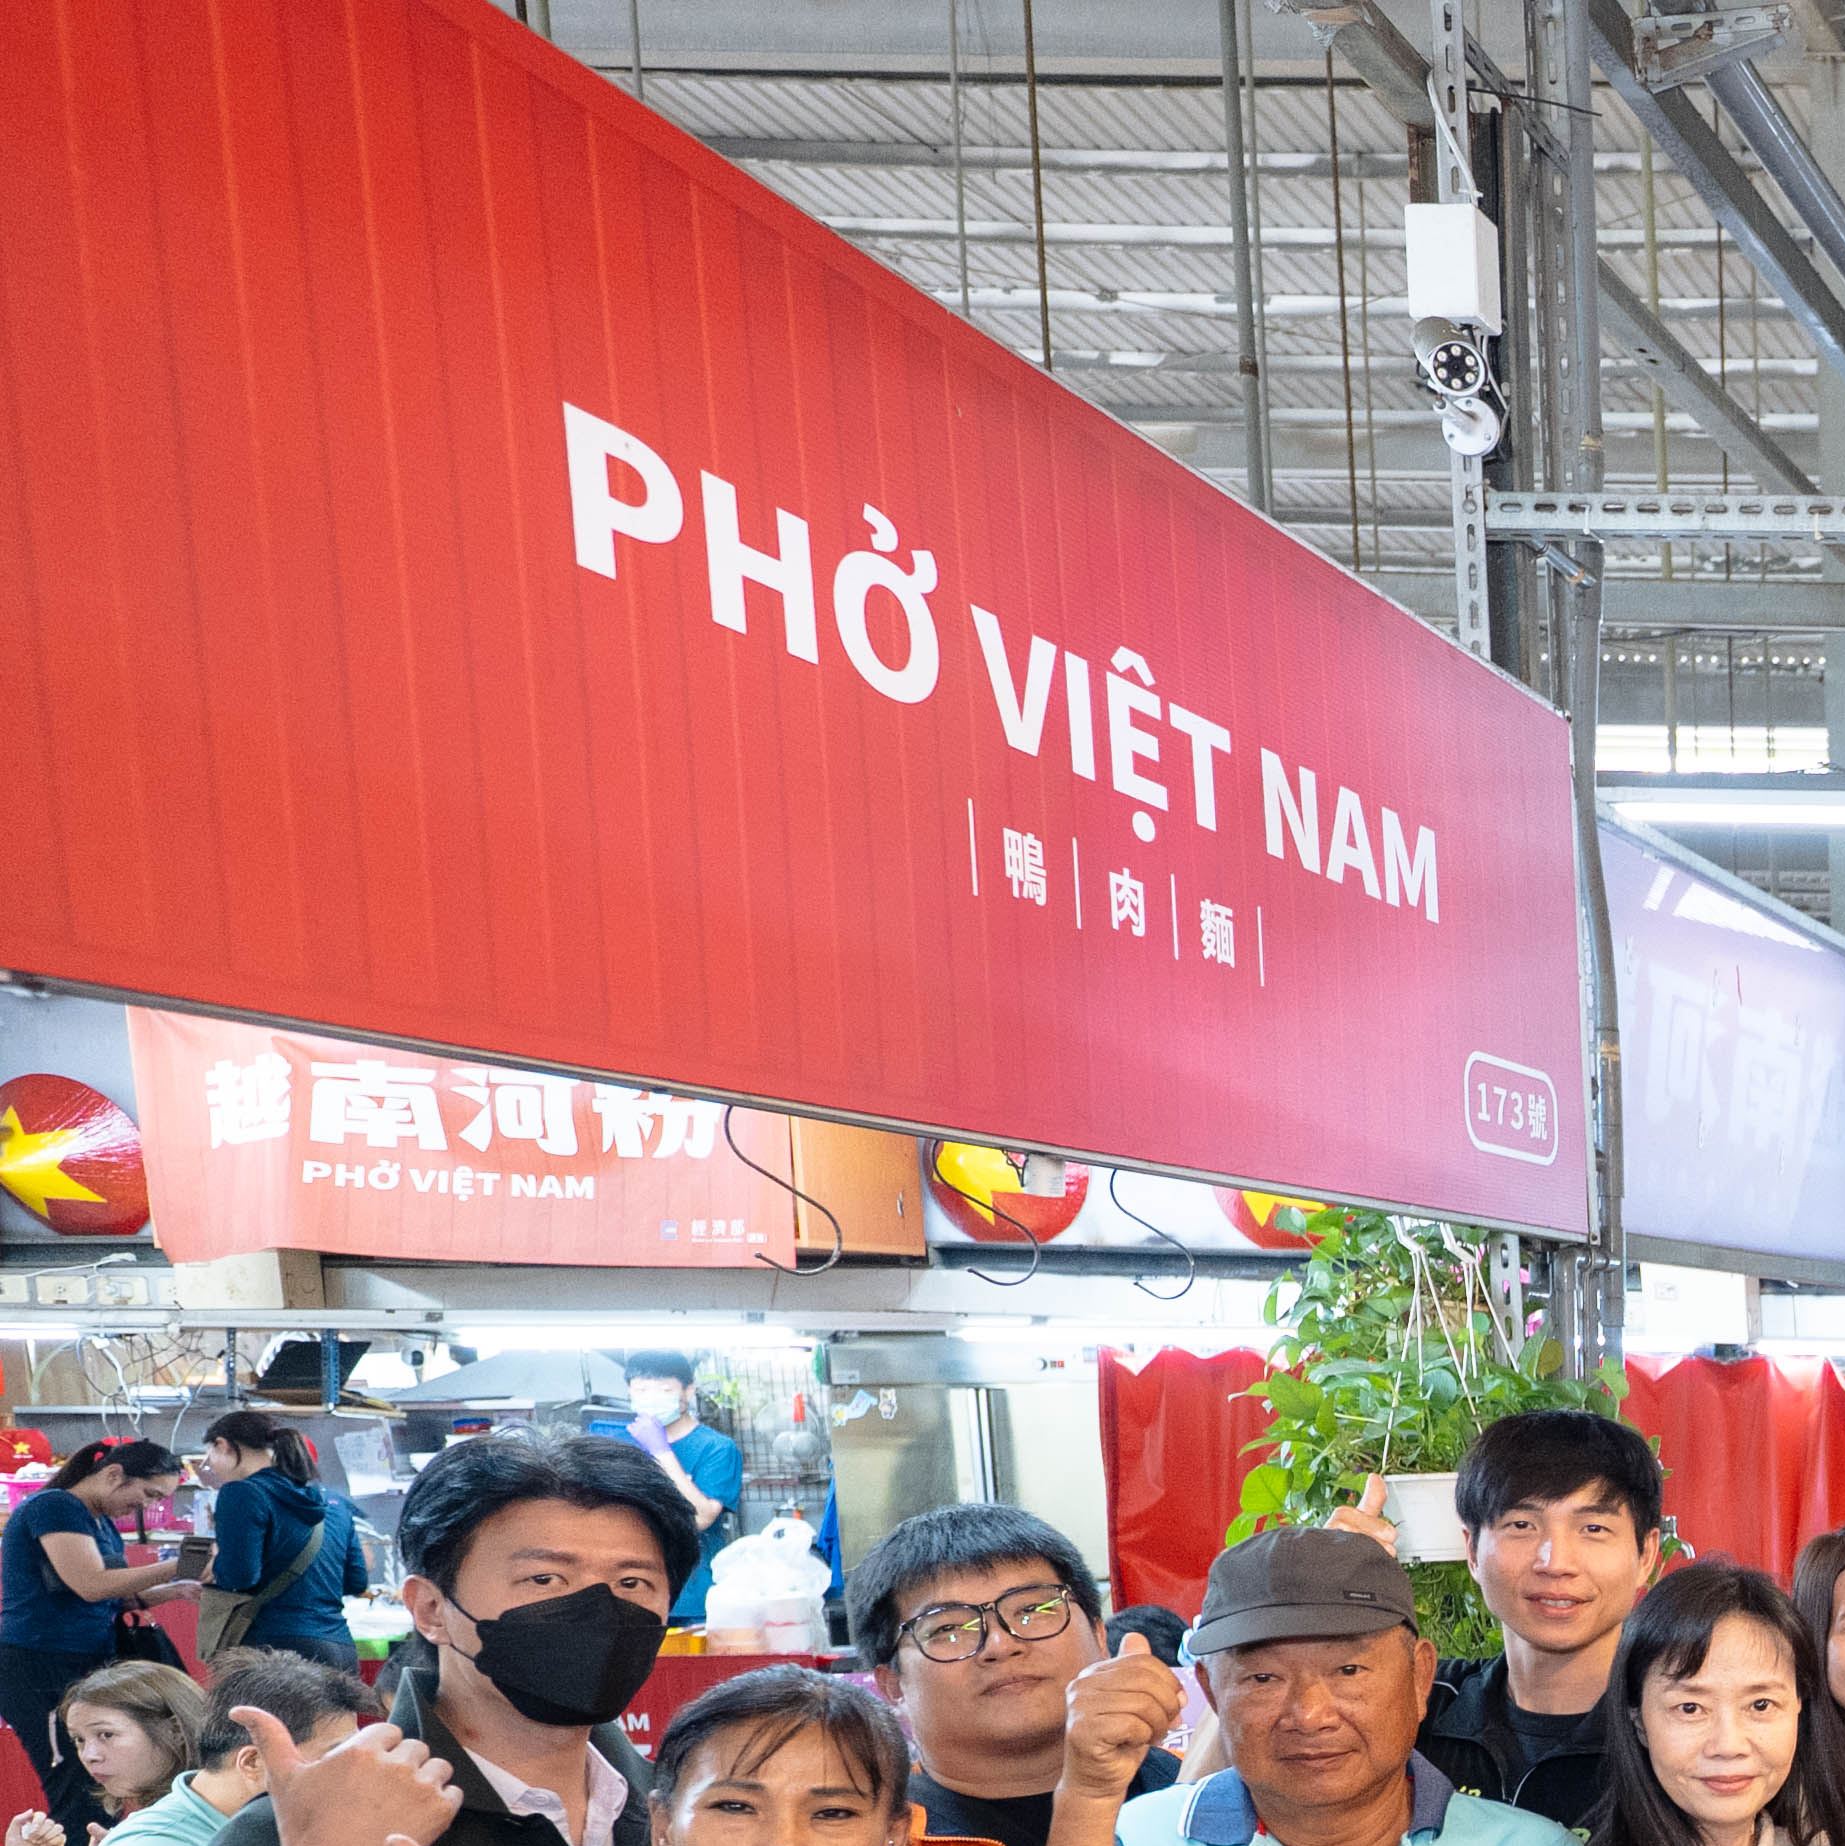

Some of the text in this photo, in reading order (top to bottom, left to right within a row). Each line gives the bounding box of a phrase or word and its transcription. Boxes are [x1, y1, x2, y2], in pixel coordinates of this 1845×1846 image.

[563, 398, 1441, 926] PHỞ VIỆT NAM
[1003, 827, 1237, 970] 鴨肉麵
[205, 1053, 727, 1160] 越南河粉
[1477, 1081, 1548, 1141] 173號
[302, 1159, 596, 1201] PHỞ VIỆT NAM
